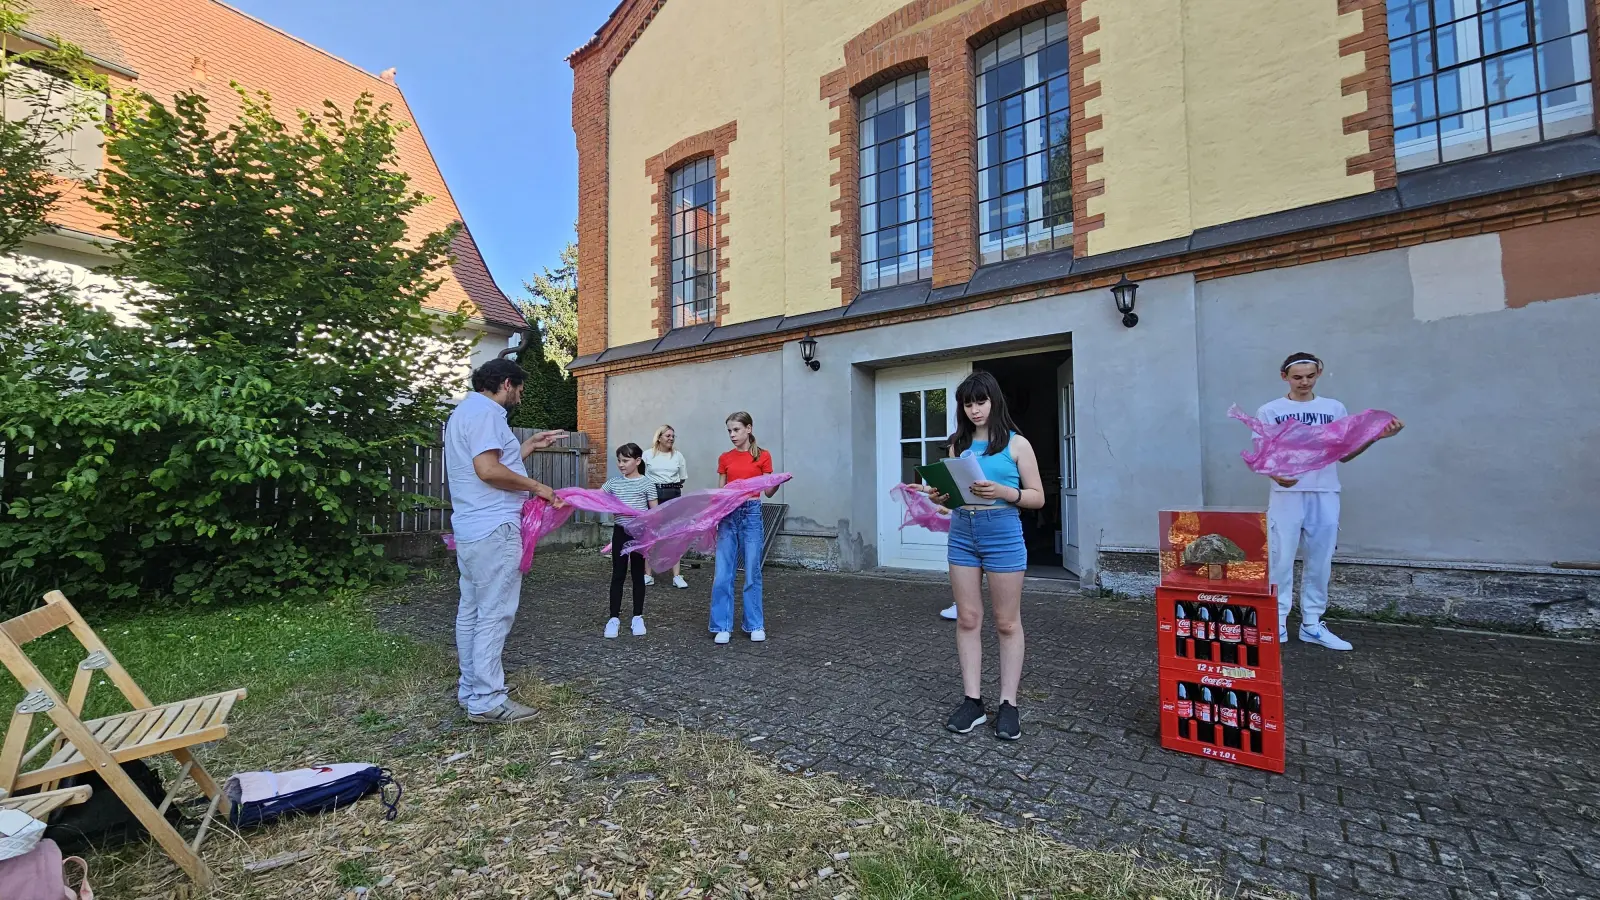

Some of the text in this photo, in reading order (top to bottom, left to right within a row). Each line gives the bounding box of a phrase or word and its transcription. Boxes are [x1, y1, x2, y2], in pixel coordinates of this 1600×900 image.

[1197, 663, 1207, 671] 12
[1202, 747, 1211, 755] 12
[1219, 751, 1230, 759] 1.0
[1231, 753, 1237, 761] L
